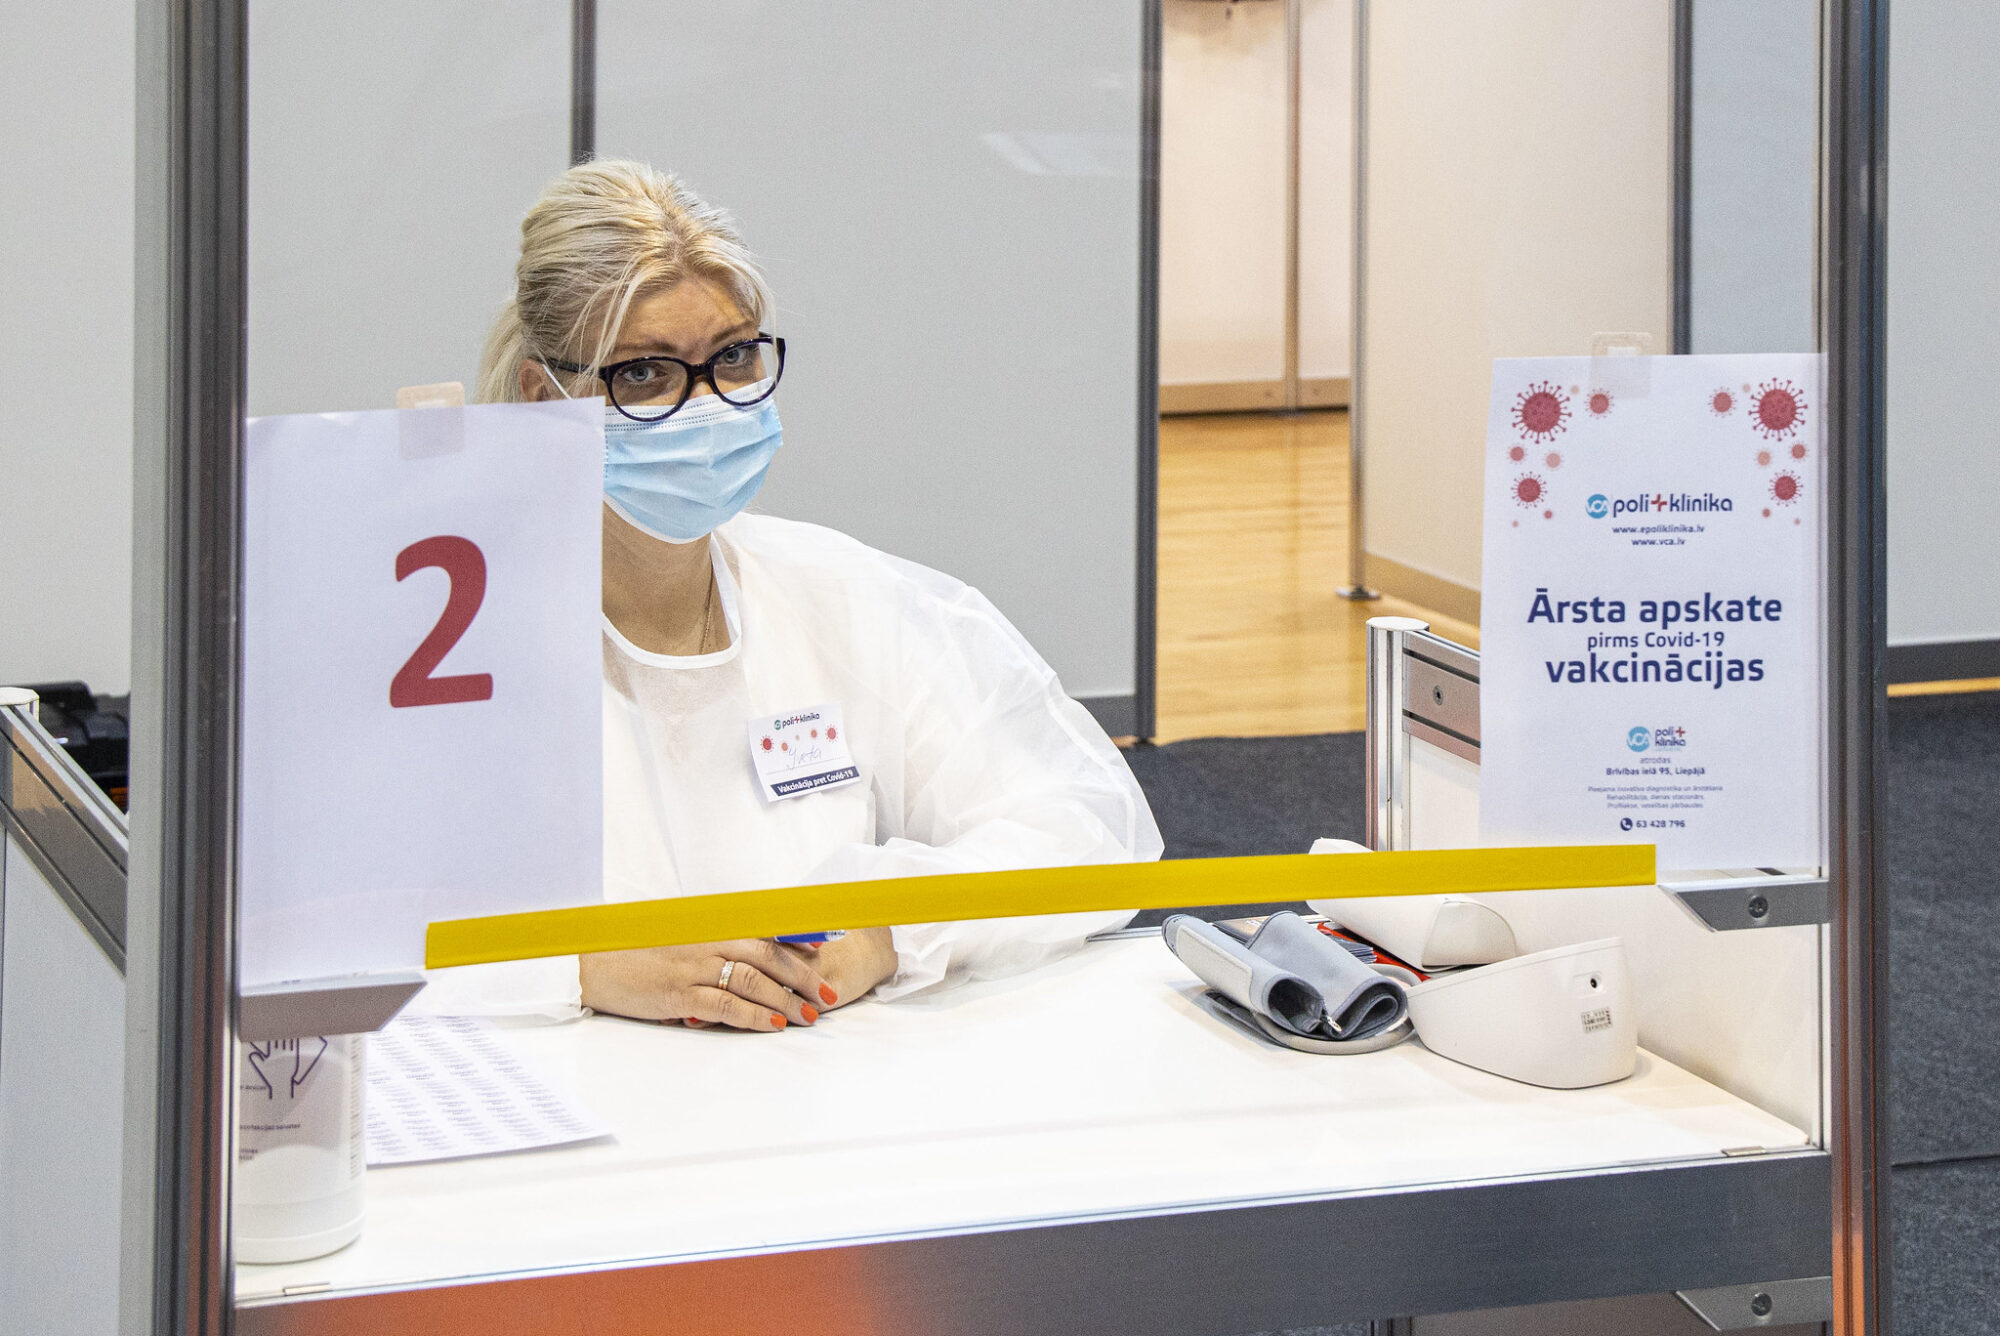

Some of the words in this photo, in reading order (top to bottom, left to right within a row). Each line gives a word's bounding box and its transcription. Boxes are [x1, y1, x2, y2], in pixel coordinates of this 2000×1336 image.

[1631, 537, 1685, 546] www.vca.lv
[1527, 588, 1626, 623] Ārsta
[1639, 592, 1783, 630] apskate
[390, 535, 494, 708] 2
[1587, 632, 1639, 651] pirms
[1645, 631, 1725, 648] Covid-19
[1545, 651, 1764, 689] vakcinācijas
[813, 776, 827, 787] pret
[826, 769, 854, 783] Covid-19
[1636, 820, 1647, 828] 63
[1650, 820, 1666, 828] 428
[1669, 820, 1686, 828] 796
